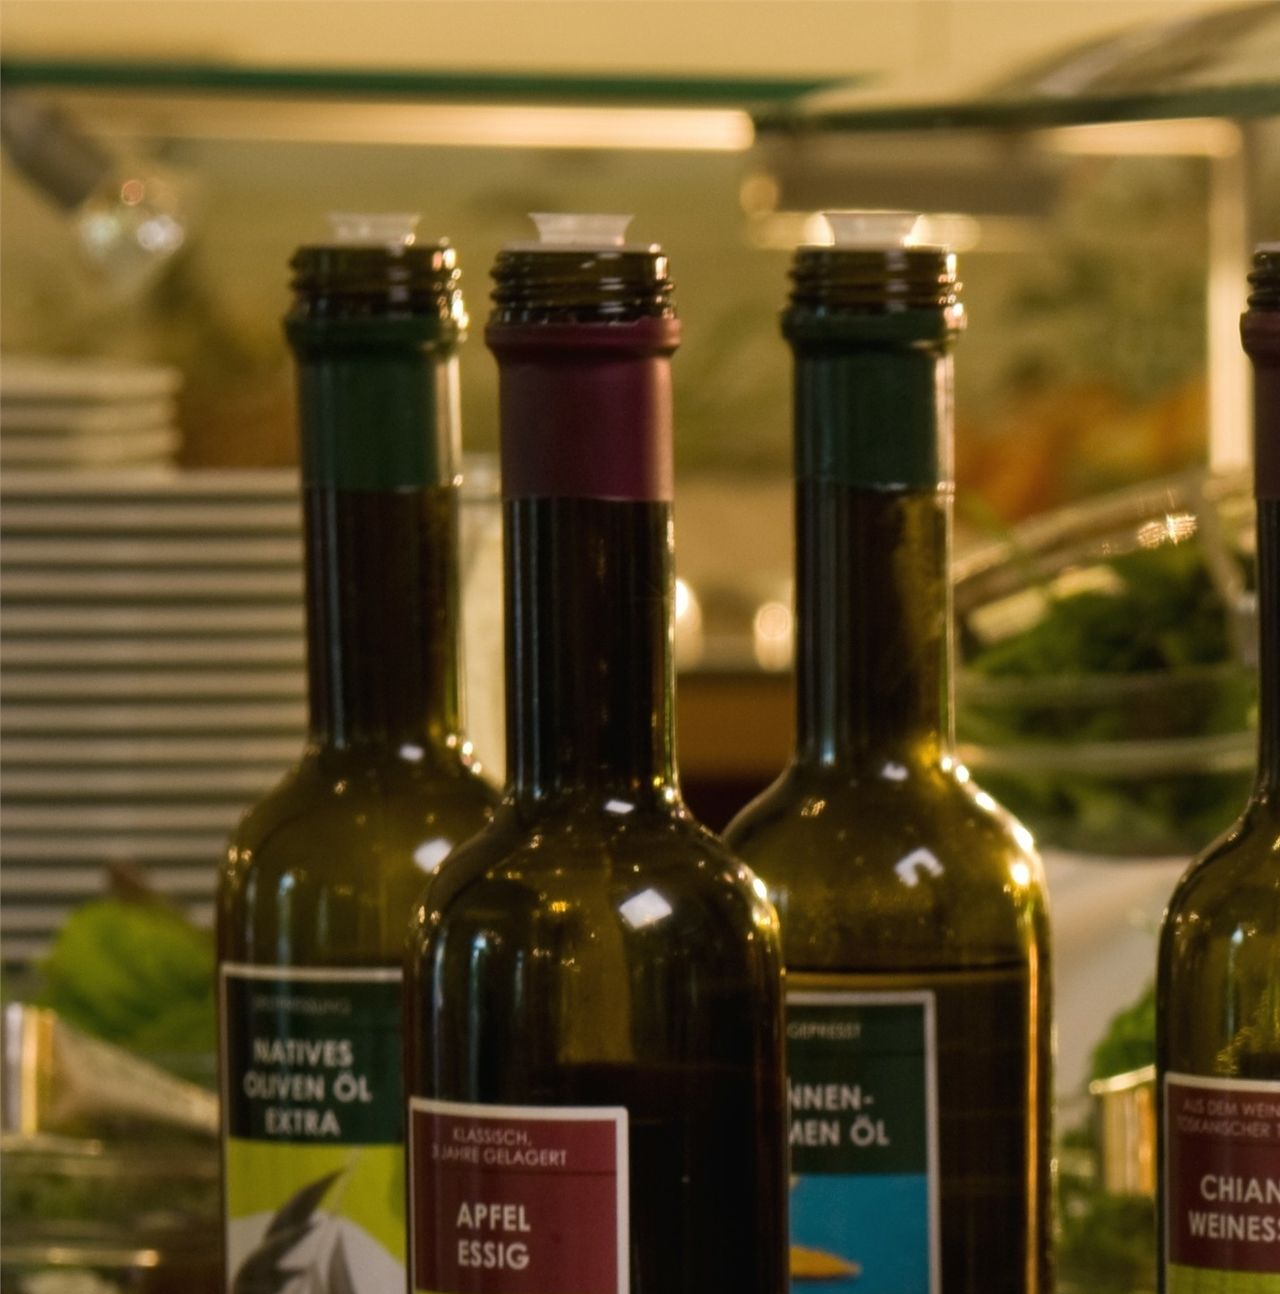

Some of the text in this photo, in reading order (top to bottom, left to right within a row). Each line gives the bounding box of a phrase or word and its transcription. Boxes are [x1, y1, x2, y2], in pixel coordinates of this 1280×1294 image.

[253, 1037, 354, 1067] NATIVES
[243, 1069, 374, 1103] OLIVEN ÖL
[787, 1083, 874, 1111] NNEN-
[264, 1107, 341, 1137] EXTRA
[1208, 1101, 1238, 1118] DEM
[788, 1114, 890, 1147] MEN ÖL
[441, 1144, 480, 1164] JAHRE
[483, 1149, 568, 1167] GELAGERT
[456, 1202, 531, 1232] APFEL
[457, 1239, 530, 1270] ESSIG
